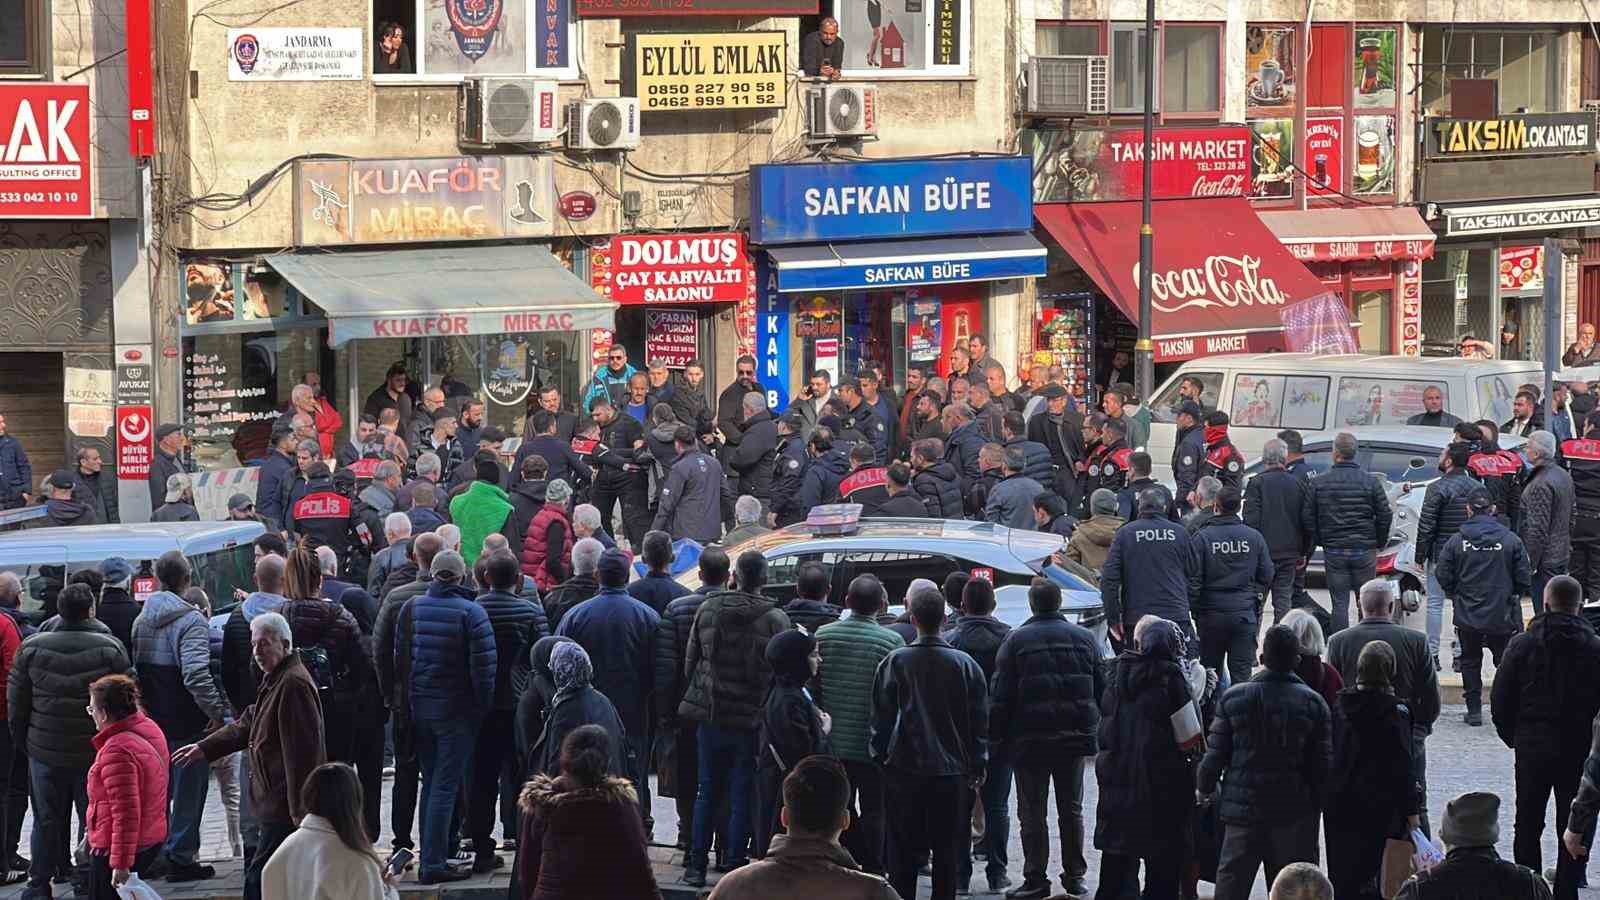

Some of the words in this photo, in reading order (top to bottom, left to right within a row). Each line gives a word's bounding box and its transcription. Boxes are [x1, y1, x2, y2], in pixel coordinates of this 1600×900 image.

[285, 35, 332, 47] JANDARMA
[642, 40, 705, 76] EYLÜL
[713, 44, 782, 74] EMLAK
[648, 84, 689, 95] 0850
[695, 83, 723, 94] 227
[730, 83, 750, 93] 90
[756, 82, 775, 92] 58
[648, 97, 689, 107] 0462
[695, 96, 725, 106] 999
[732, 95, 750, 105] 11
[755, 94, 775, 104] 52
[541, 95, 552, 127] VESTEL
[864, 90, 875, 130] VESTEL
[0, 97, 80, 161] AK
[1437, 118, 1524, 153] TAKSİM
[1522, 124, 1588, 148] LOKANTASI
[1112, 137, 1174, 162] TAKSİM
[1180, 140, 1246, 159] MARKET
[0, 169, 39, 177] SULTING
[42, 168, 78, 177] OFFICE
[352, 162, 502, 196] KUAFÖR
[23, 192, 44, 202] 042
[48, 192, 61, 202] 10
[65, 192, 78, 202] 10
[804, 184, 910, 216] SAFKAN
[924, 177, 992, 209] BÜFE
[1457, 216, 1514, 230] TAKSİM
[621, 239, 737, 266] DOLMUŞ
[1375, 241, 1392, 257] ÇAY
[616, 272, 648, 289] ÇAY
[655, 269, 742, 286] KAHVALTI
[865, 267, 924, 282] SAFKAN
[932, 262, 970, 278] BÜFE
[644, 287, 713, 302] SALONU
[373, 314, 468, 336] KUAFÖR
[661, 312, 693, 323] FARAN
[673, 334, 695, 344] UMRE
[1159, 340, 1194, 356] TAKSİM
[1207, 335, 1246, 352] MARKET
[122, 446, 147, 455] BÜYÜK
[122, 456, 147, 464] BİRLİK
[121, 465, 149, 475] PARTİSİ
[974, 569, 990, 580] 112
[136, 582, 152, 592] 112
